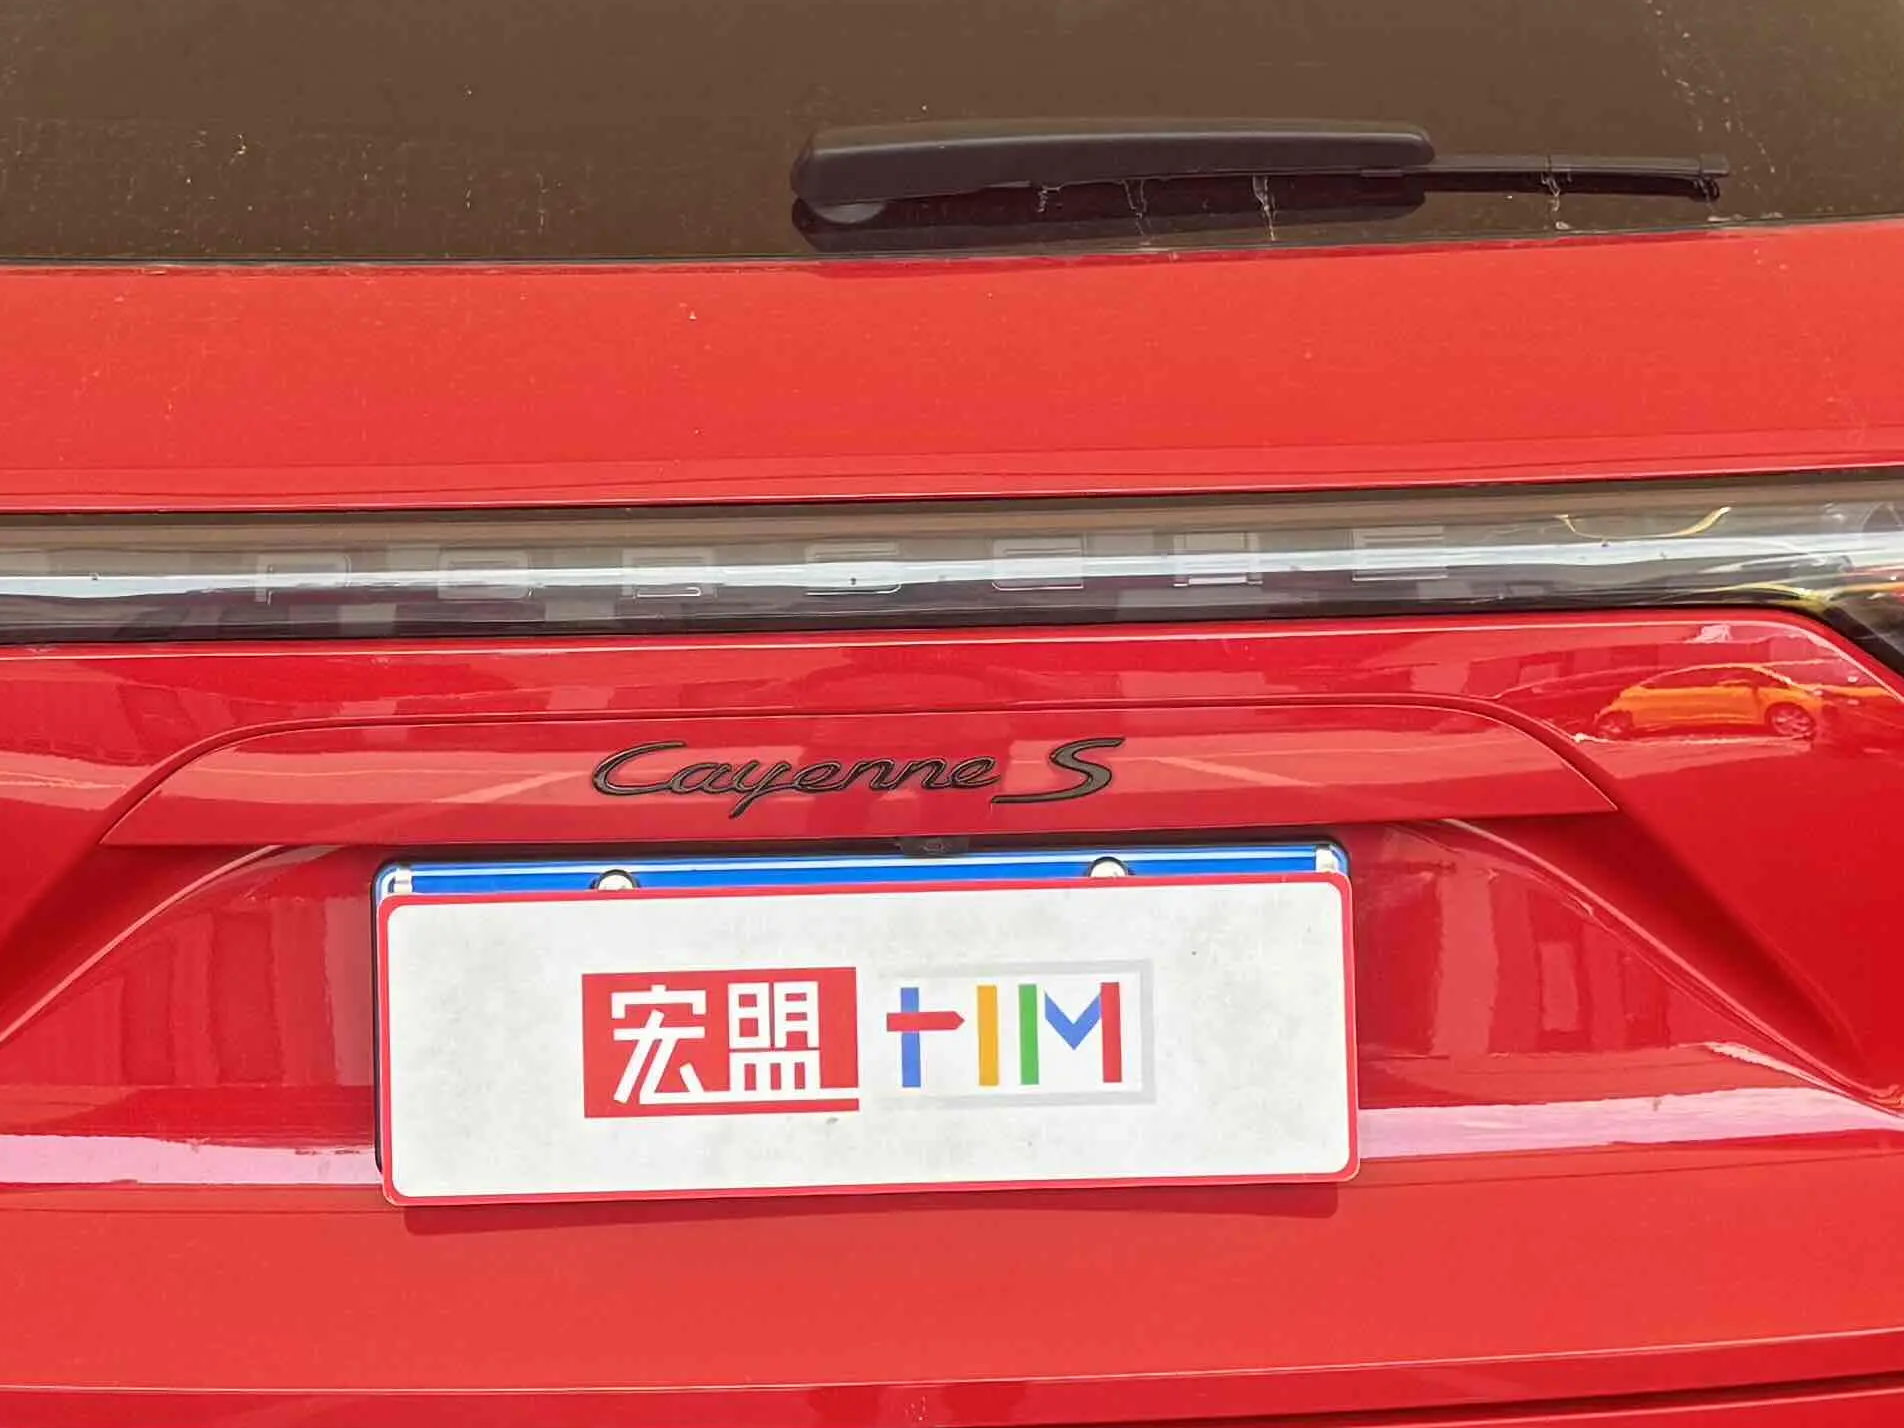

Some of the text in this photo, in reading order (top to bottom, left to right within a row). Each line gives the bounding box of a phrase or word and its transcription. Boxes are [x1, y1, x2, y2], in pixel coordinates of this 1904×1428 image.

[591, 736, 1124, 818] Cayenne S
[611, 980, 860, 1103] 宏盟
